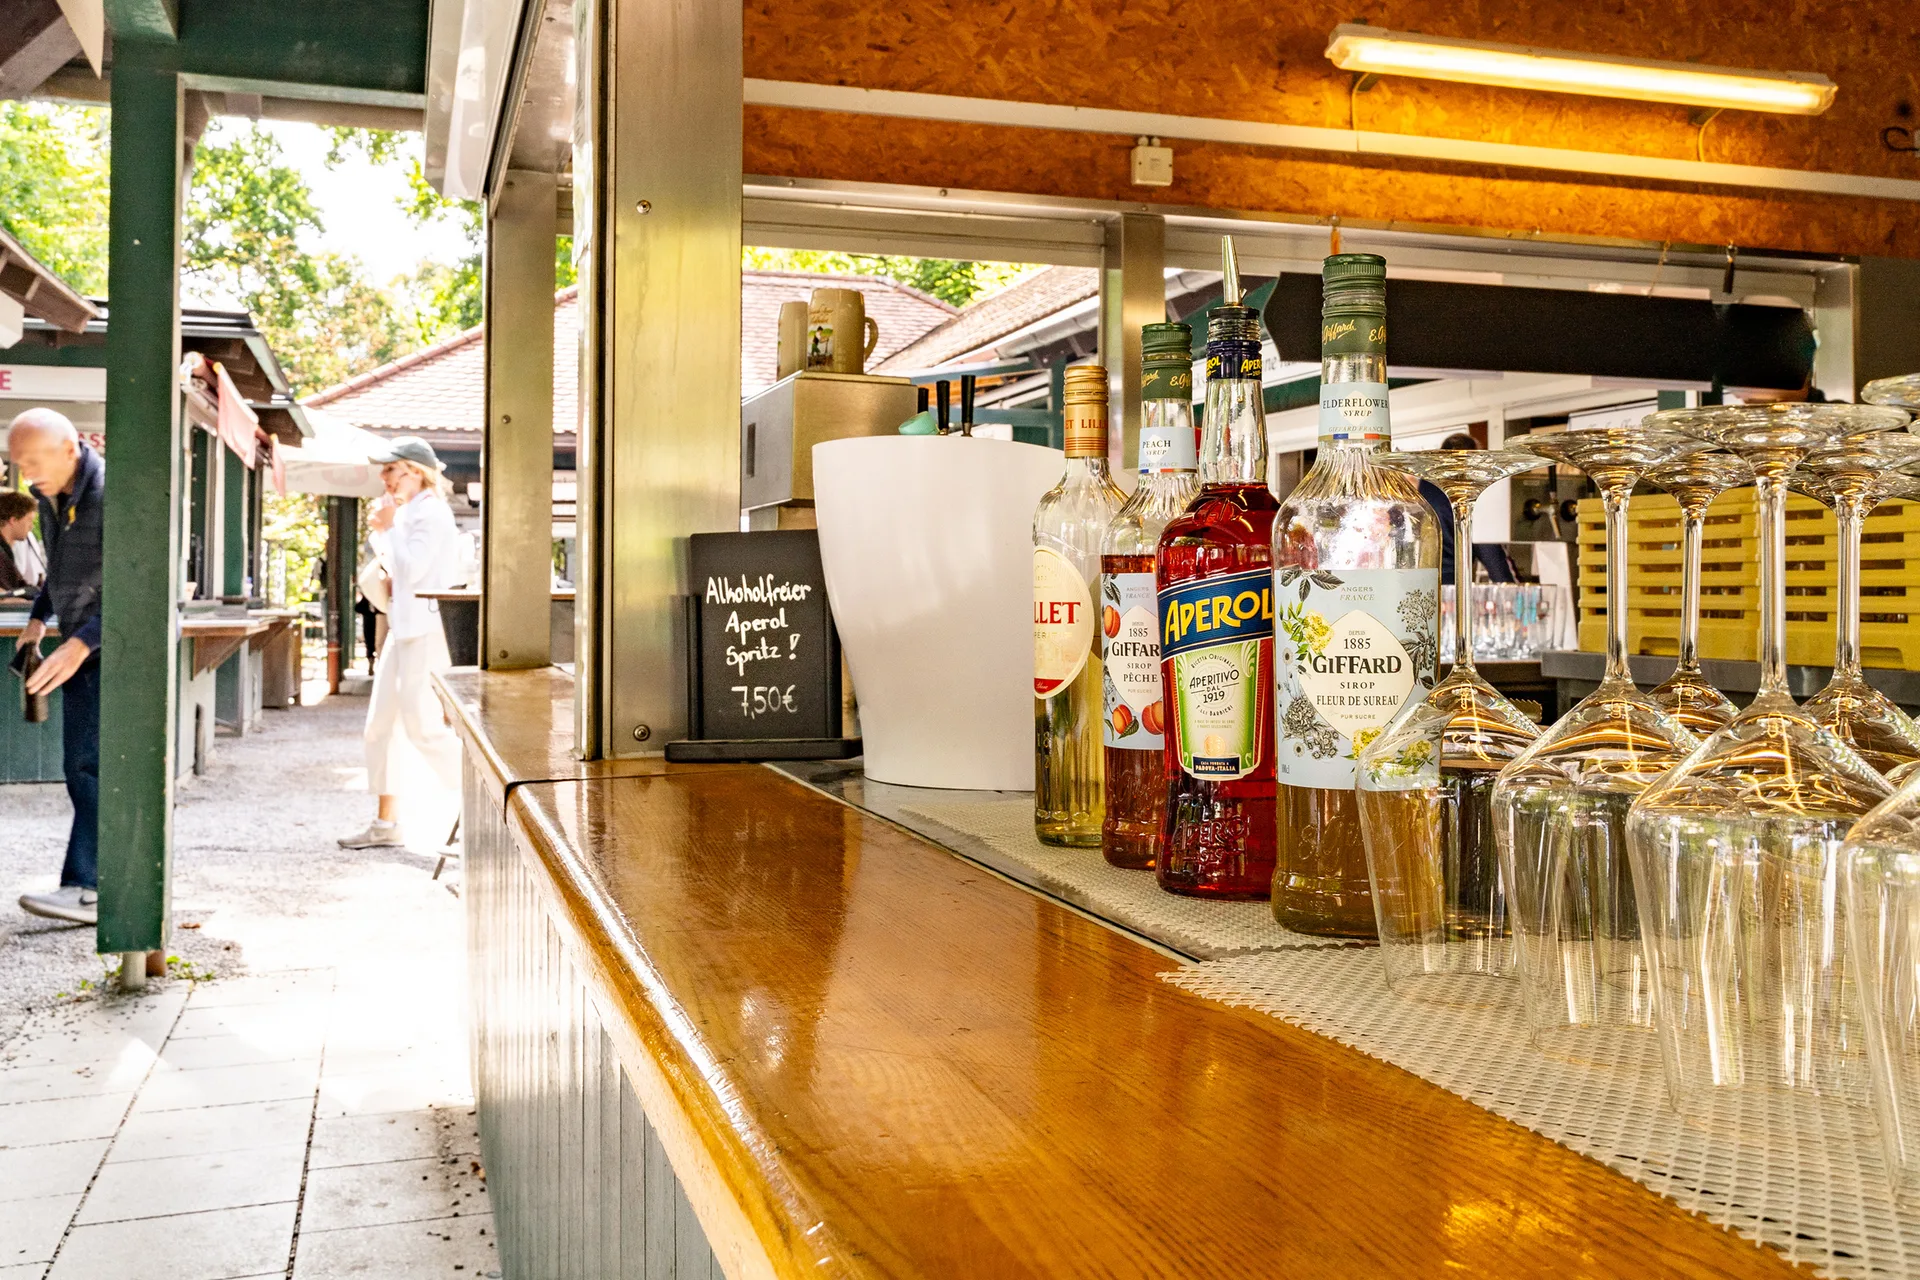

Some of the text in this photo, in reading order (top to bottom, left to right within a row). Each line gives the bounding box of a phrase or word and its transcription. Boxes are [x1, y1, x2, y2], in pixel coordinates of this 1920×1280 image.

[1240, 358, 1262, 373] APER
[1322, 398, 1389, 409] ELDERFLOWER
[1142, 439, 1171, 449] PEACH
[1164, 587, 1275, 646] APEROL
[725, 607, 789, 646] Aperol
[1129, 627, 1148, 638] 1885
[1343, 637, 1371, 650] 1885
[726, 636, 782, 677] Spritz
[1312, 655, 1402, 674] GIFFARD
[1123, 672, 1158, 683] PÊCHE
[1189, 669, 1240, 689] APERITIVO
[1206, 685, 1220, 693] DAL
[1339, 681, 1376, 689] SIROP
[731, 684, 798, 720] 7,50€
[1202, 690, 1225, 704] 1919
[1316, 695, 1399, 706] FLEUR DE SUREAU
